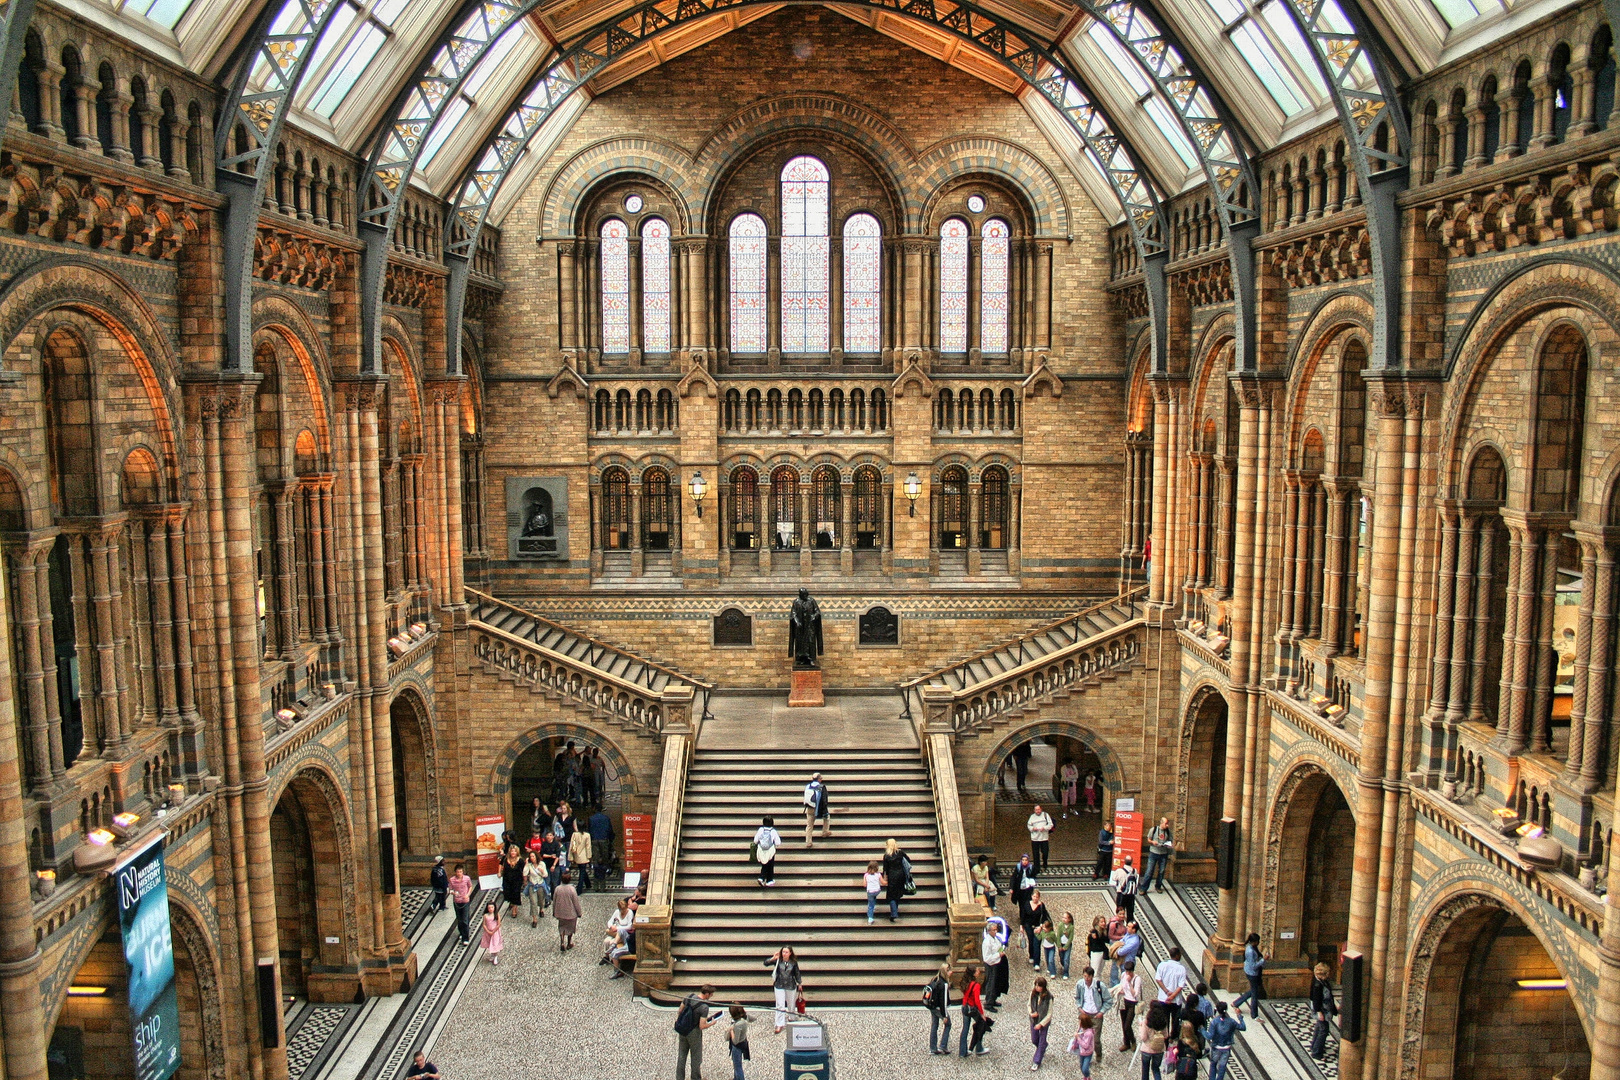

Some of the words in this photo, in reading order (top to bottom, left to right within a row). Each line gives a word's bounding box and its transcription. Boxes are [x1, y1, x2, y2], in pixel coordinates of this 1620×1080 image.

[137, 859, 161, 880] NATURAL
[138, 866, 161, 889] HISTORY
[120, 866, 140, 909] N
[139, 875, 161, 897] MUSEUM
[135, 1015, 161, 1052] ship
